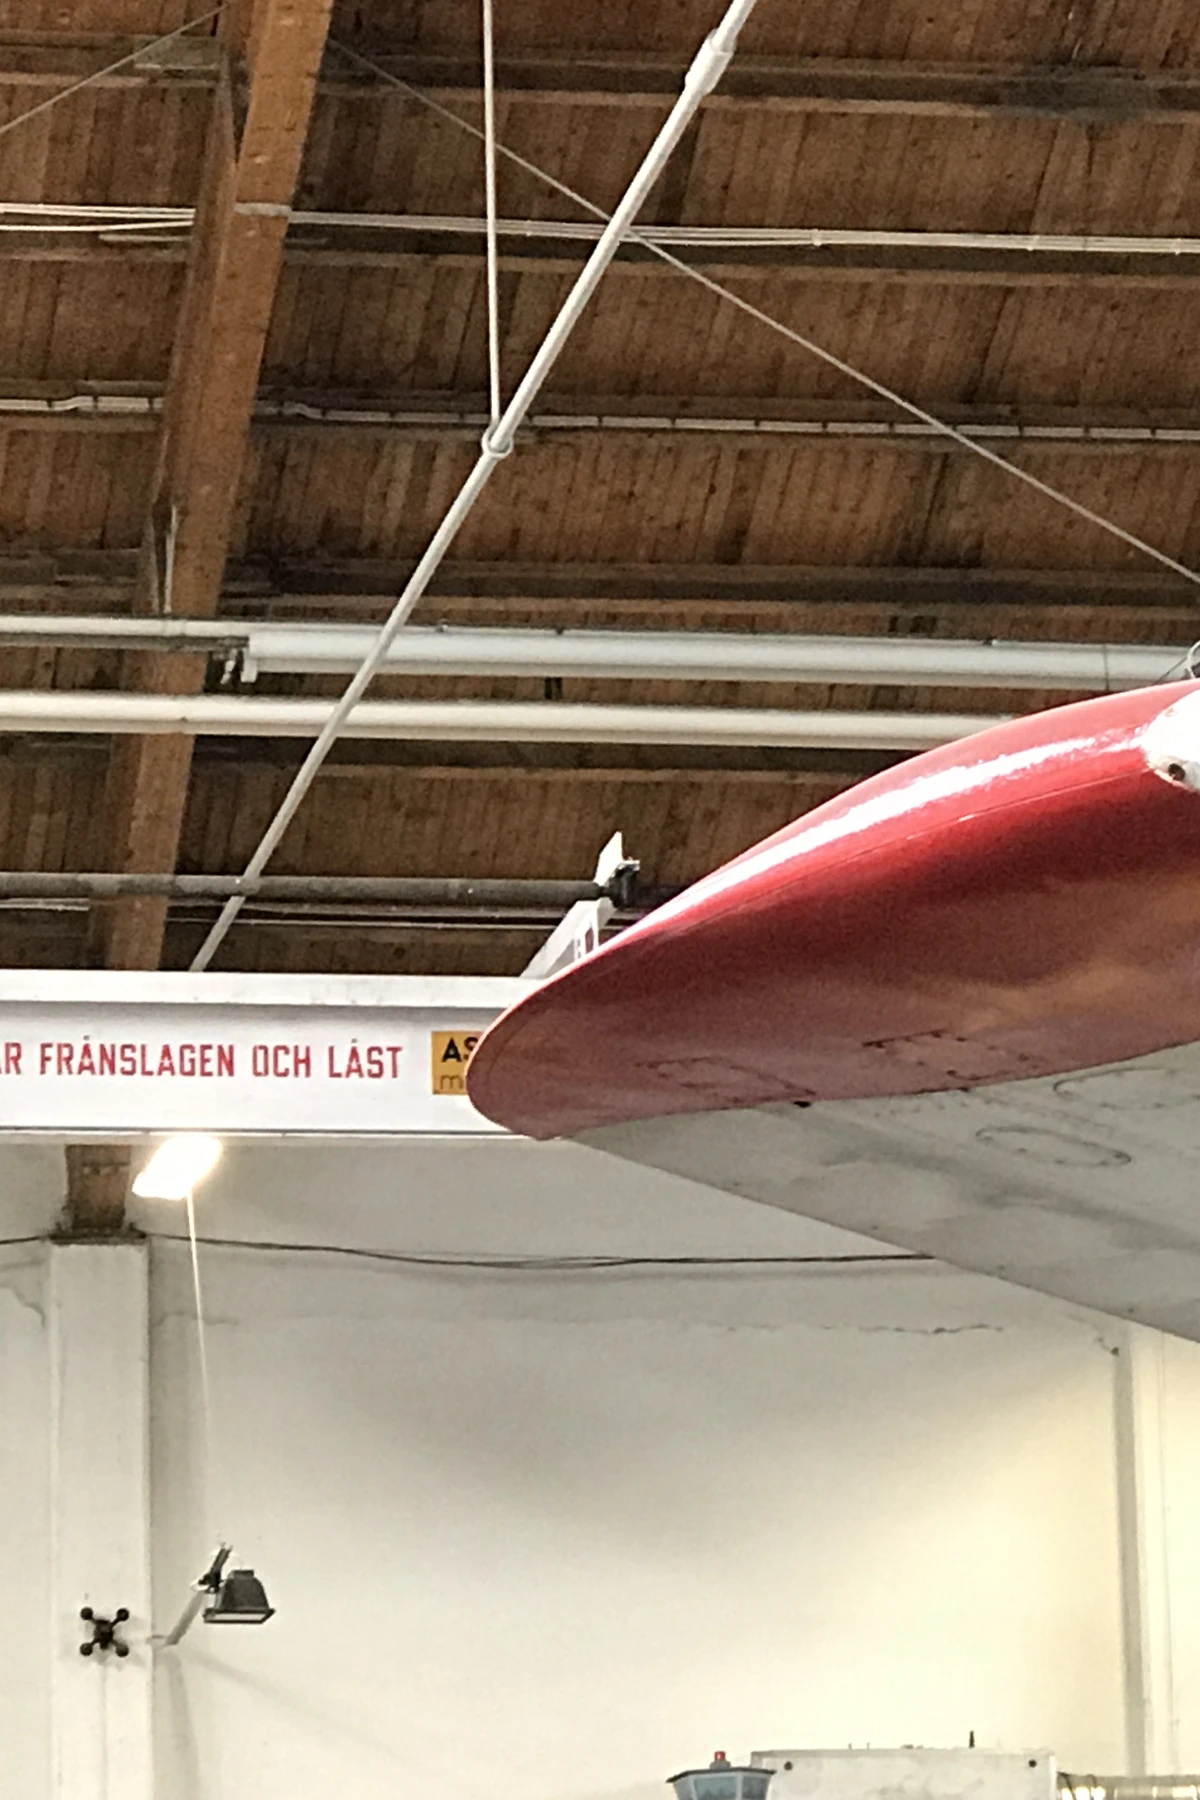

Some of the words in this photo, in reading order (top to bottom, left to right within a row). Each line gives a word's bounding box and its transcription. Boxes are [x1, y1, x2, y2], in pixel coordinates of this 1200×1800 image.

[39, 1035, 235, 1077] FRÅNSLAGEN
[252, 1044, 311, 1078] OCH
[328, 1038, 403, 1079] LÅST
